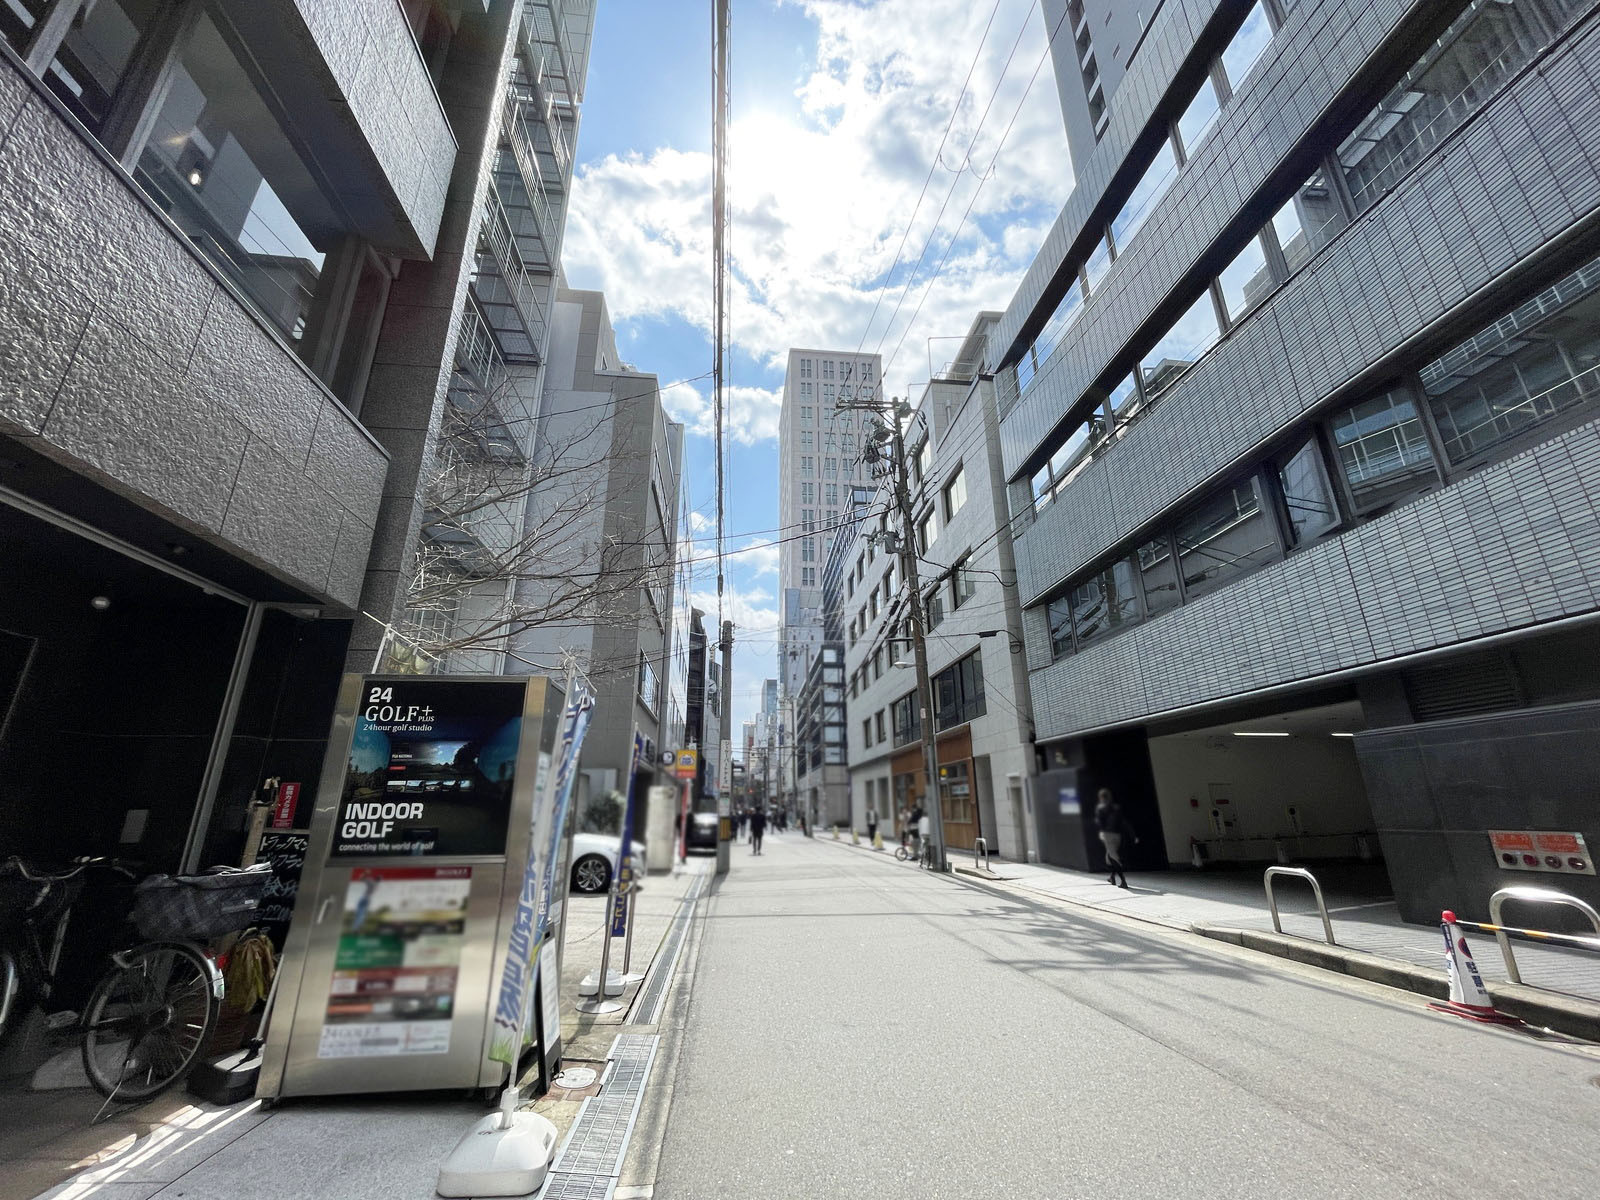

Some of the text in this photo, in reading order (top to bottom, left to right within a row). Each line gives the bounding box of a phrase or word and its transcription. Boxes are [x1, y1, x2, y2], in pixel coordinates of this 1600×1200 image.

[369, 686, 393, 703] 24
[363, 723, 391, 731] 24hour
[392, 723, 408, 733] golf
[345, 802, 424, 820] INDOOR
[341, 821, 394, 838] GOLF
[339, 842, 377, 851] connecting
[378, 842, 390, 850] the
[391, 842, 411, 850] world
[412, 842, 421, 850] of
